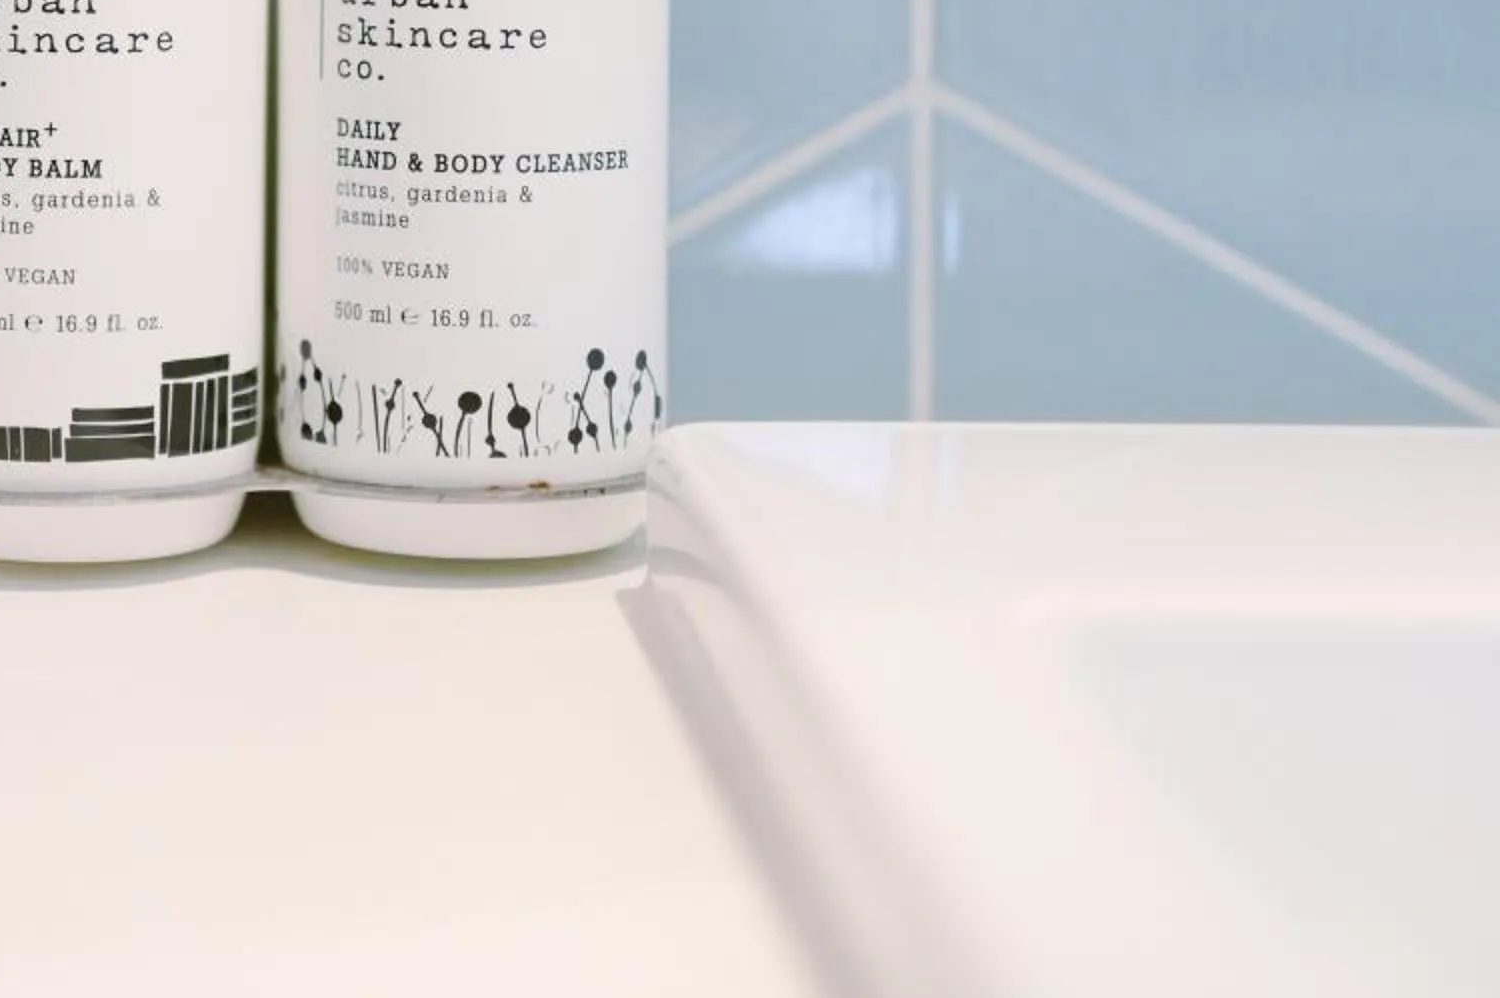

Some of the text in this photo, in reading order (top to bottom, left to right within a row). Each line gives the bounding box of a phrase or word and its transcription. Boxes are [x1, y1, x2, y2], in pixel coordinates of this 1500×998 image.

[337, 17, 548, 50] skincare
[337, 58, 384, 81] co.
[337, 118, 401, 141] DAILY
[28, 159, 102, 178] BALM
[337, 147, 628, 174] HAND & BODY CLEANSER
[31, 189, 134, 212] gardenia
[147, 188, 161, 207] &
[337, 181, 532, 206] citrus, gardenia &
[334, 207, 410, 230] jasmine
[4, 267, 75, 285] VEGAN
[337, 256, 449, 279] 100% VEGAN
[56, 314, 97, 333] 16.9
[107, 314, 124, 332] fl.
[137, 316, 162, 330] oz.
[335, 301, 362, 321] 500
[369, 305, 391, 324] ml
[431, 309, 470, 328] 16.9
[480, 309, 499, 328] fl.
